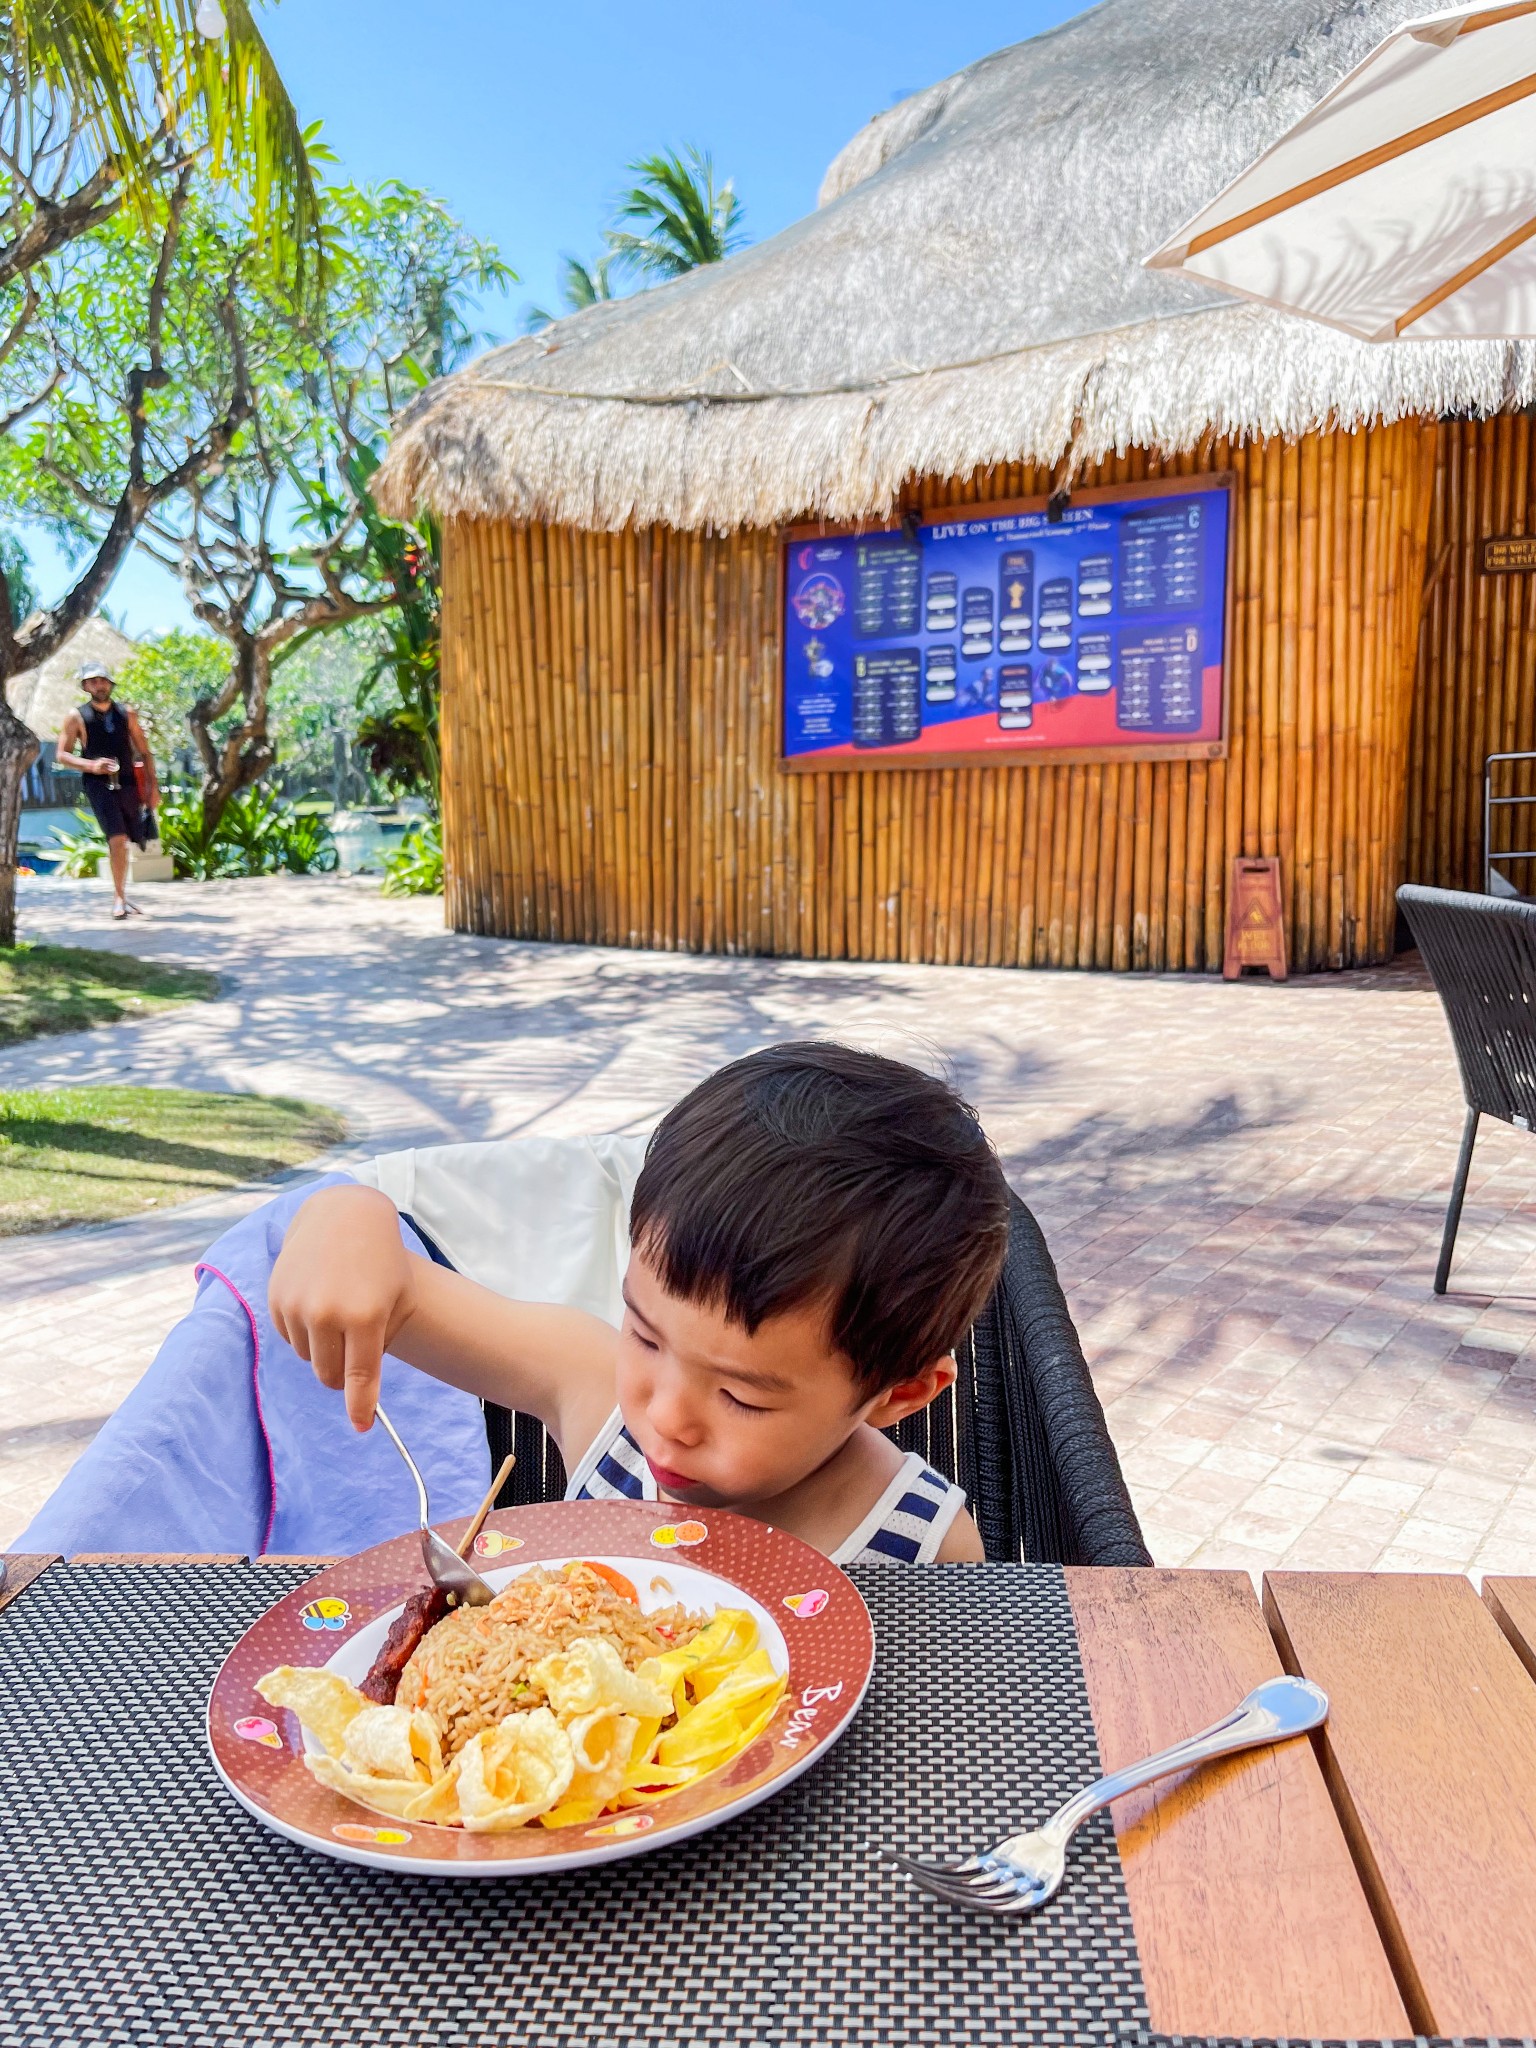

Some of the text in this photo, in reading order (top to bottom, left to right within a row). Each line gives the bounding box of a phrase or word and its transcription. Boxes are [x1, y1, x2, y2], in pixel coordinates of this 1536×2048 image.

[932, 523, 968, 540] LIVE
[968, 522, 989, 535] ON
[991, 518, 1015, 532] THE
[1018, 515, 1041, 529] BIG
